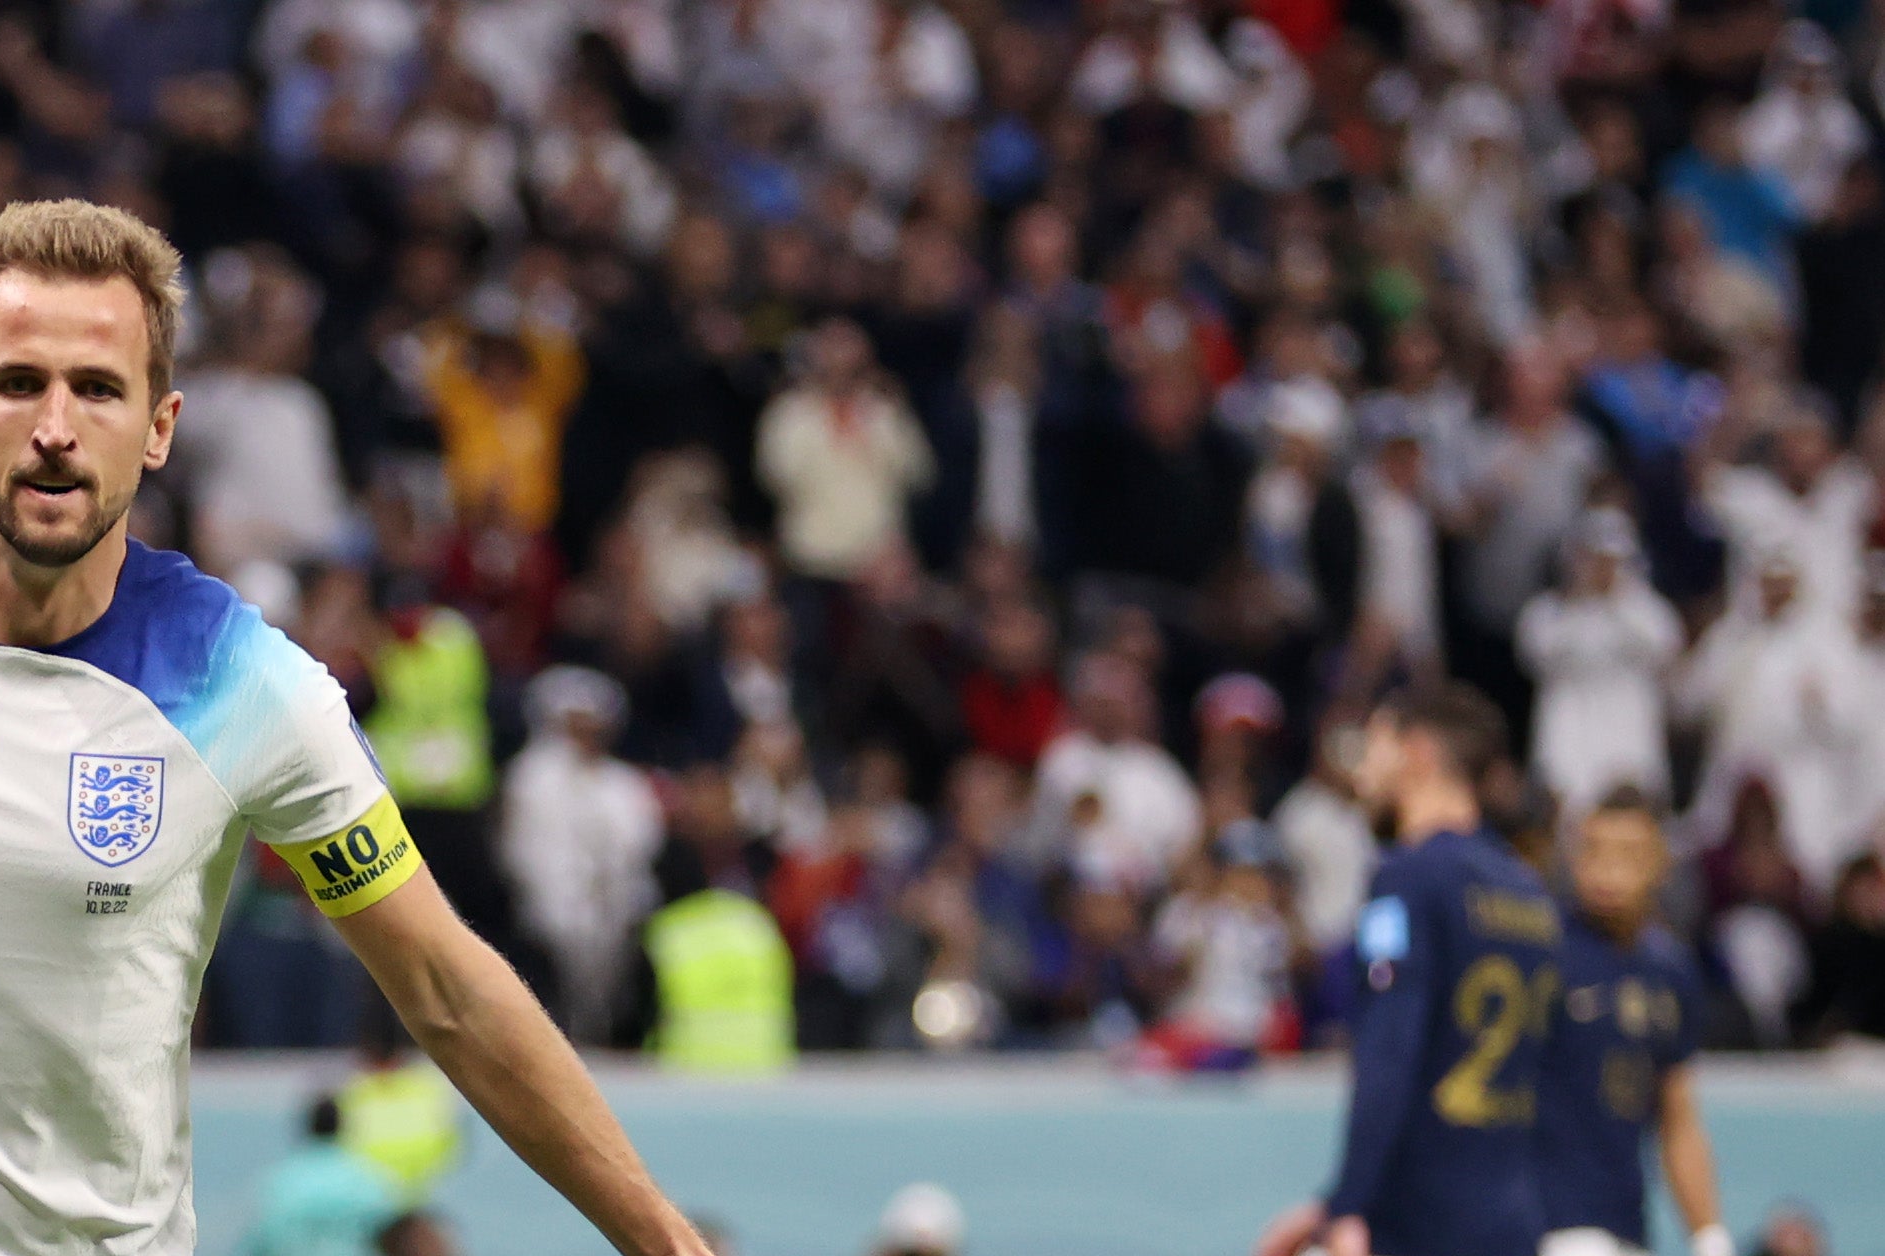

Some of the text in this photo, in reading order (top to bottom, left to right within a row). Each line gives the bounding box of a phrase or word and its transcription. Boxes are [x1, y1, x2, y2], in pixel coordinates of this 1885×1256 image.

[310, 824, 380, 884] NO
[86, 881, 133, 897] FRANCE
[85, 900, 129, 915] 10.12.22
